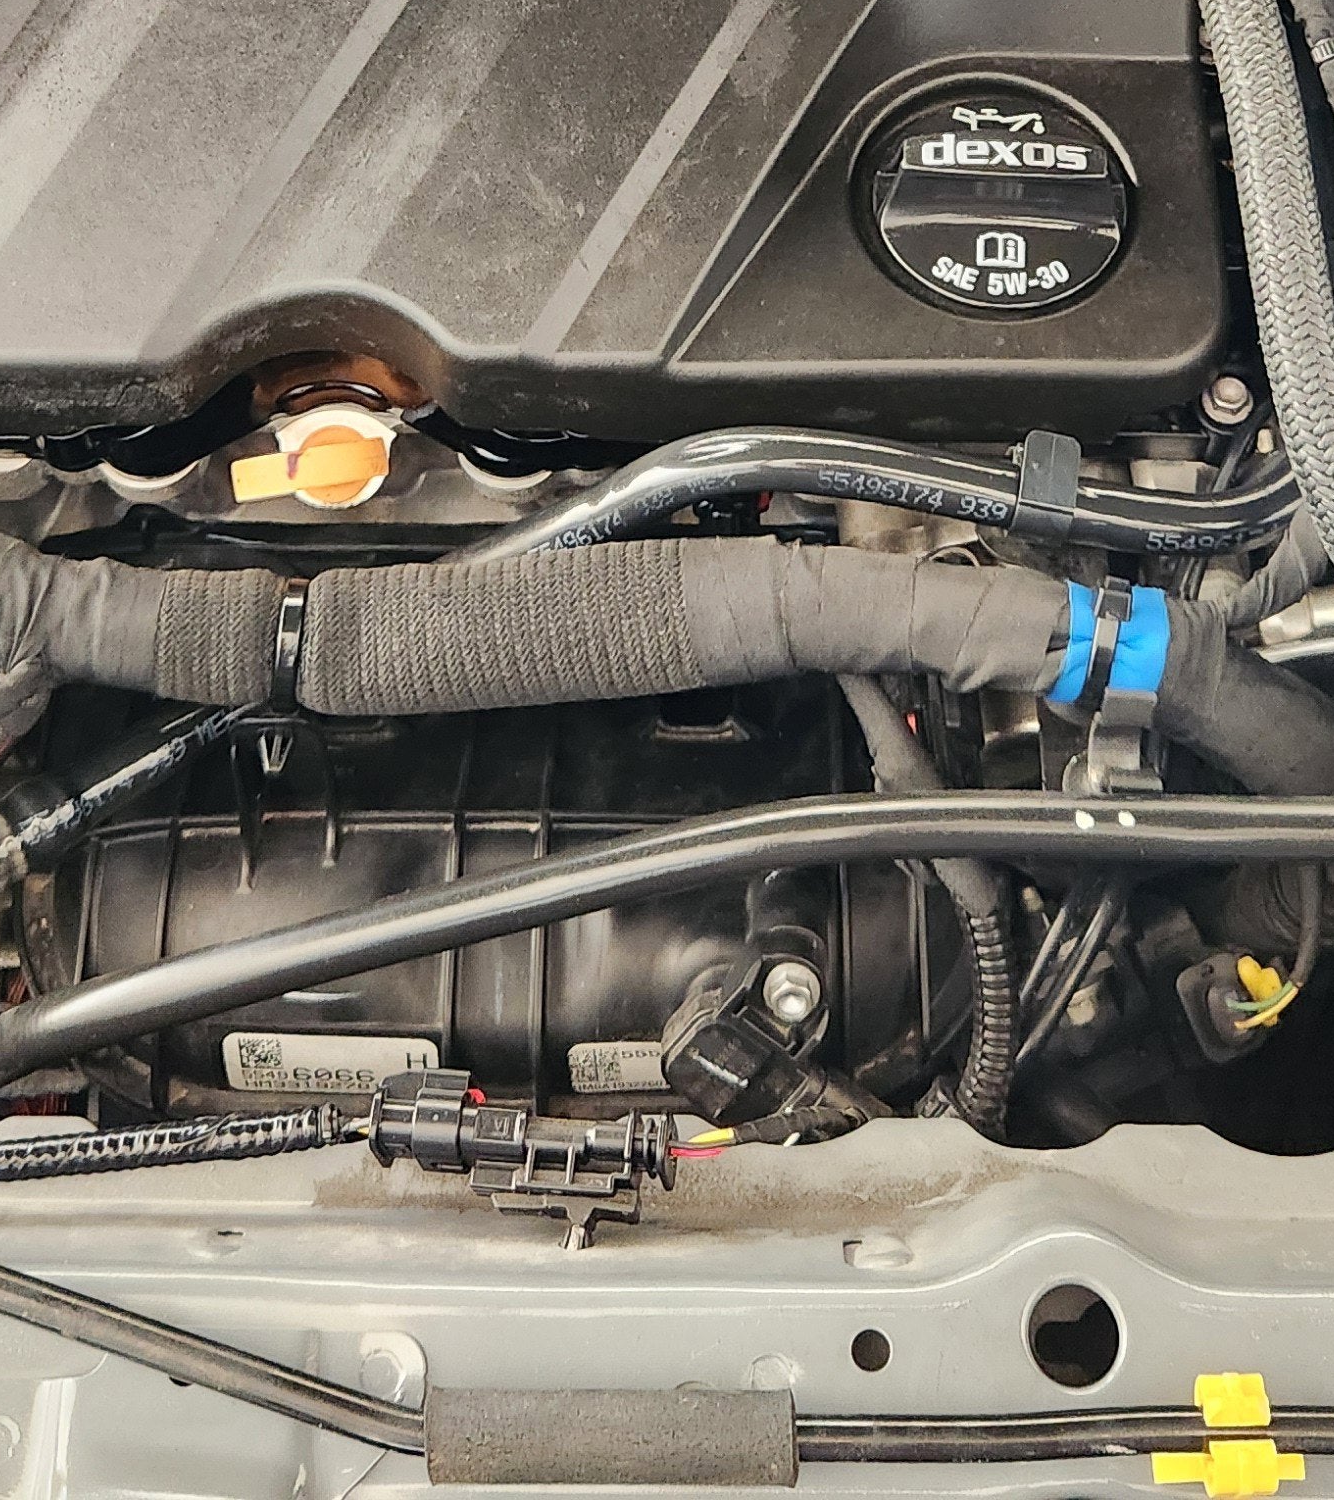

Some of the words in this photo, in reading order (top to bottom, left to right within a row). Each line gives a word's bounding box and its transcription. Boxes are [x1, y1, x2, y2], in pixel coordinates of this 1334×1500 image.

[921, 133, 1093, 172] dexos
[931, 256, 980, 292] SAE
[986, 260, 1071, 297] 5W-30
[817, 468, 944, 513] 55496174
[956, 494, 1009, 520] 939
